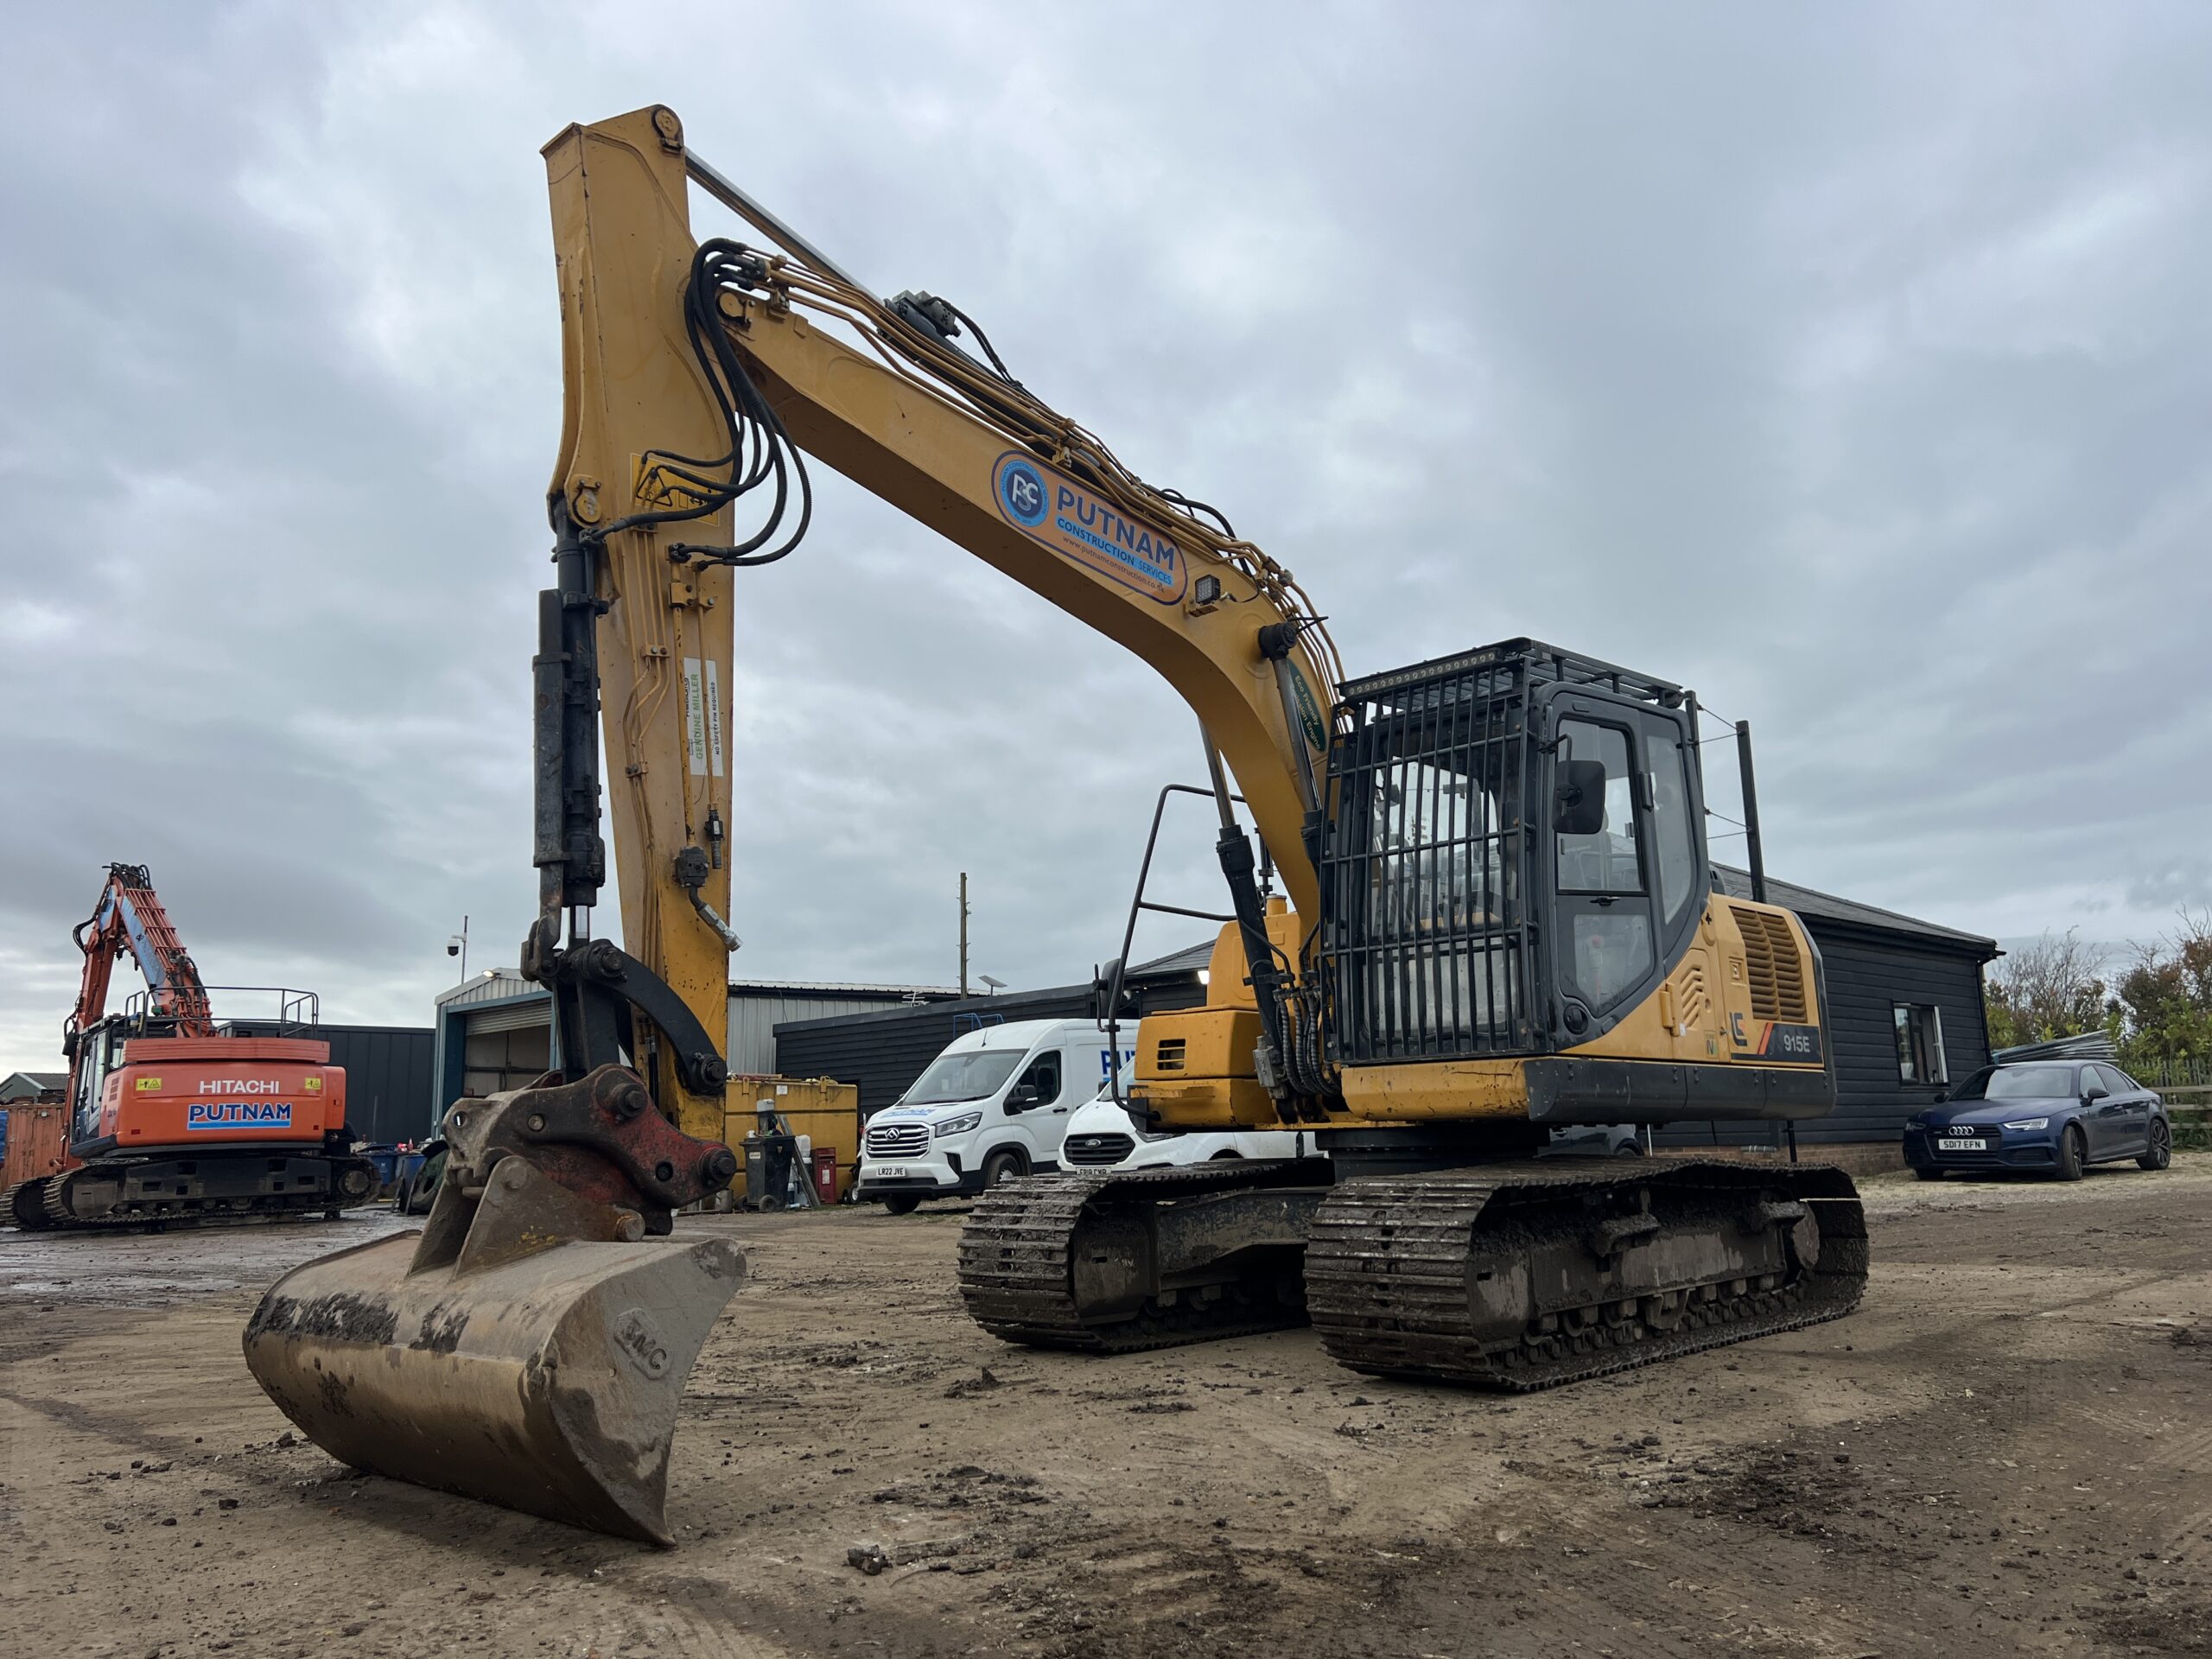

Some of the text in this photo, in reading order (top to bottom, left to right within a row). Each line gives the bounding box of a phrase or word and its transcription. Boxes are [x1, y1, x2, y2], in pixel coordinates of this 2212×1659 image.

[1057, 485, 1174, 571] PUTNAM
[1058, 518, 1173, 585] CONSTRUCTION SERVICES
[1294, 676, 1319, 726] Eco Friendly
[1306, 721, 1321, 749] Engine
[1783, 1034, 1811, 1053] 915E
[200, 1080, 279, 1094] HITACHI
[189, 1103, 291, 1121] PUTNAM
[878, 1167, 904, 1176] LR22 JYE
